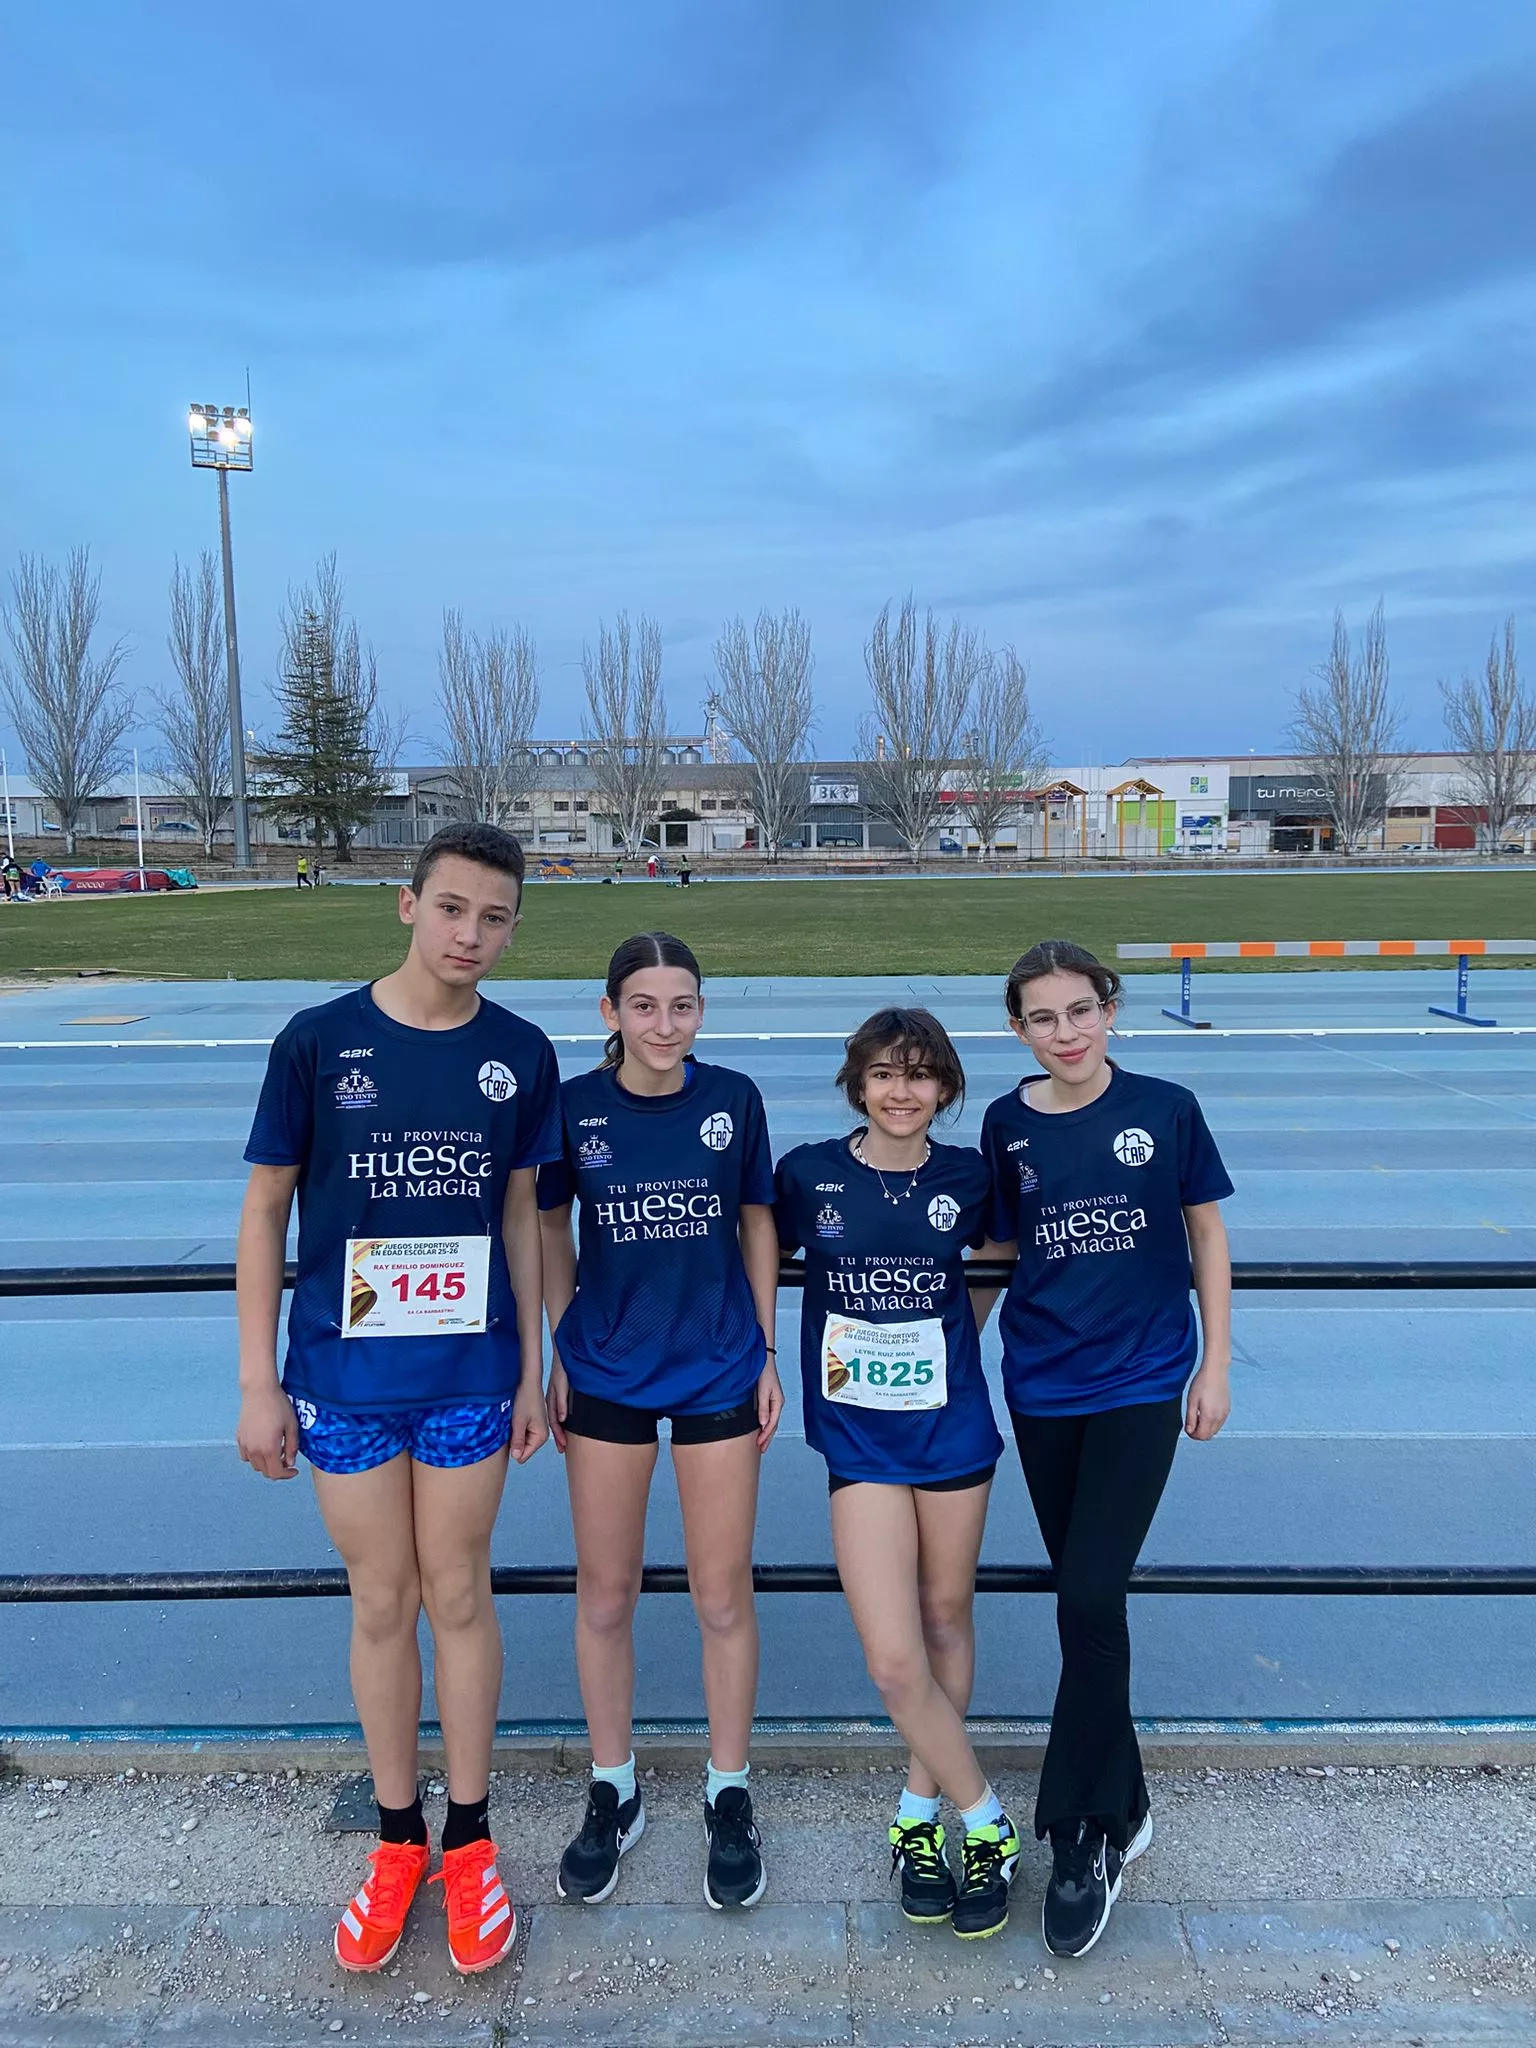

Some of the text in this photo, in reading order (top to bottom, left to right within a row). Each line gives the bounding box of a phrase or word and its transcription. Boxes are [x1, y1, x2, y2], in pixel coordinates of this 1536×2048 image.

[1256, 788, 1275, 798] tu
[339, 1048, 374, 1058] 42K
[486, 1079, 509, 1100] CAB
[578, 1117, 608, 1127] 42K
[708, 1131, 726, 1148] CAB
[1007, 1138, 1030, 1152] 42K
[1123, 1146, 1146, 1164] CAB
[815, 1183, 846, 1193] 42K
[936, 1212, 953, 1229] CAB
[384, 1242, 412, 1250] JUEGOS
[414, 1242, 460, 1250] DEPORTIVOS
[404, 1248, 437, 1256] ESCOLAR
[392, 1272, 466, 1302] 145
[856, 1328, 879, 1338] JUEGOS
[845, 1358, 934, 1387] 1825
